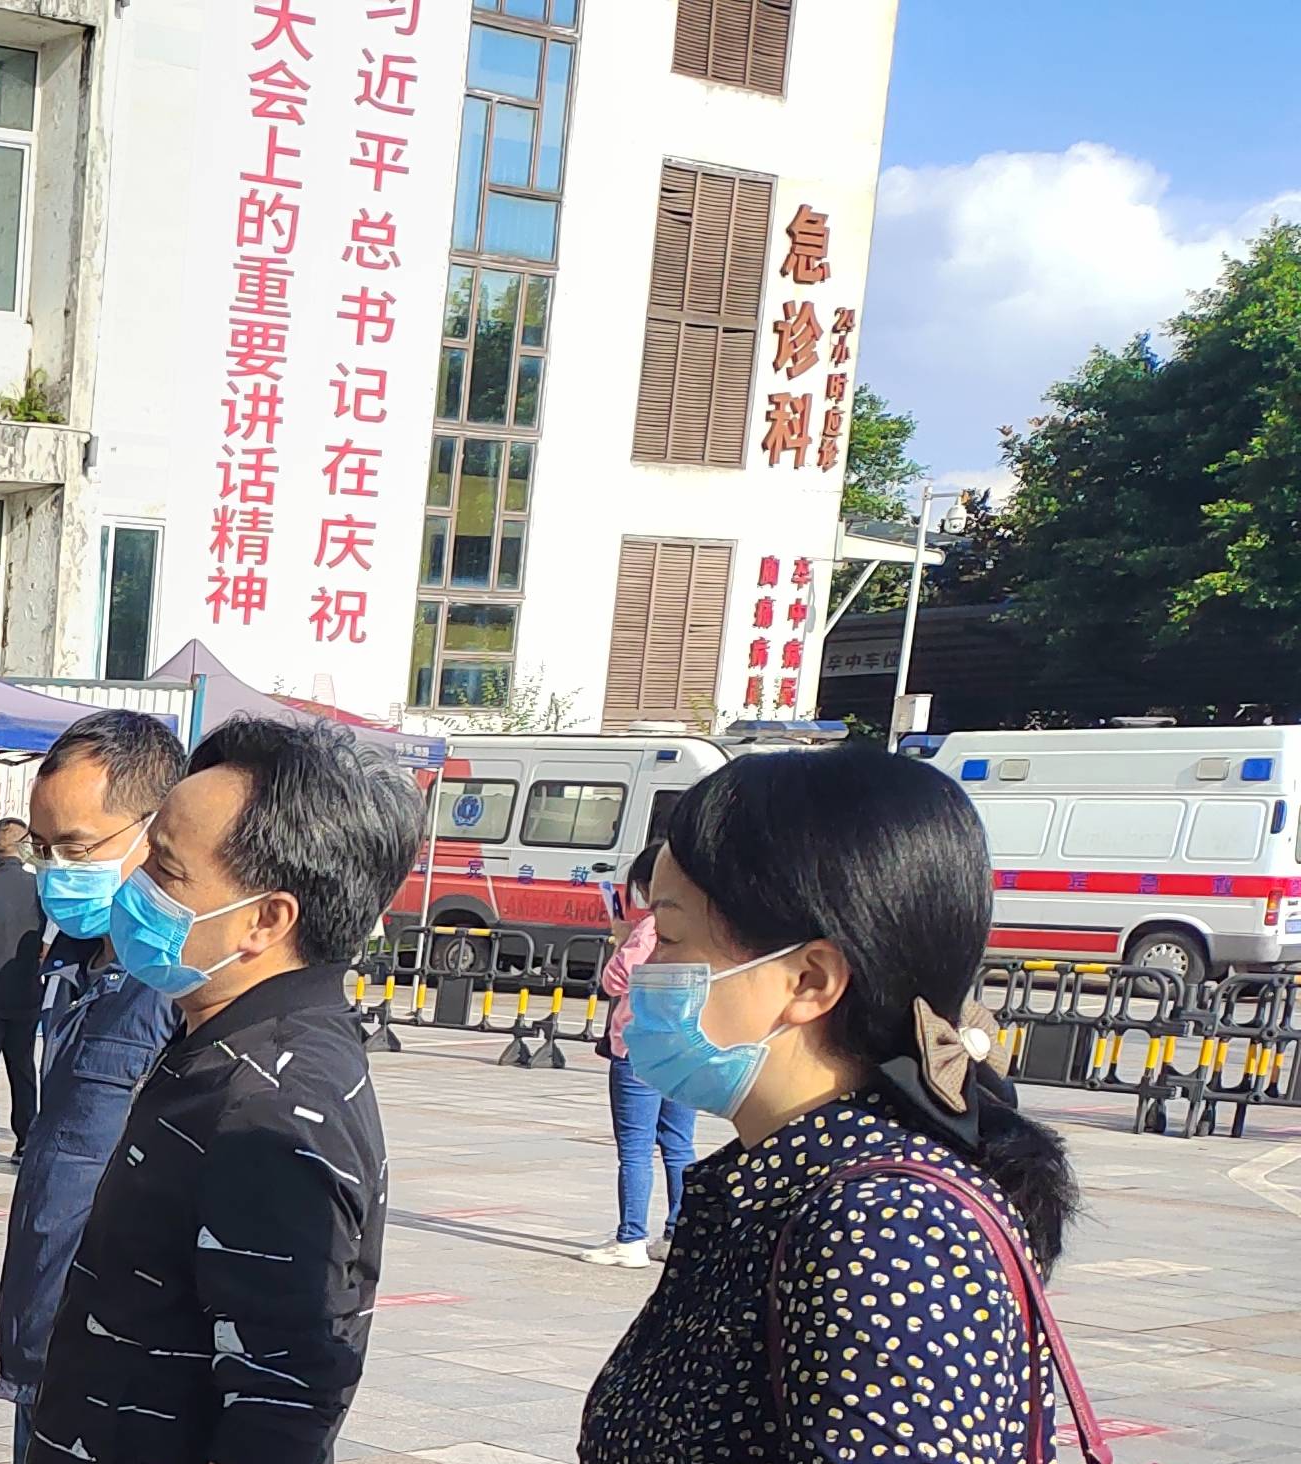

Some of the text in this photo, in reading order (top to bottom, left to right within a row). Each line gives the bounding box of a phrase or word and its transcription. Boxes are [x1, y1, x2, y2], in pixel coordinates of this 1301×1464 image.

[205, 0, 317, 625] 大会上的重要讲话精神
[309, 0, 421, 644] 习近平总书记在庆祝
[761, 203, 831, 470] 急诊科
